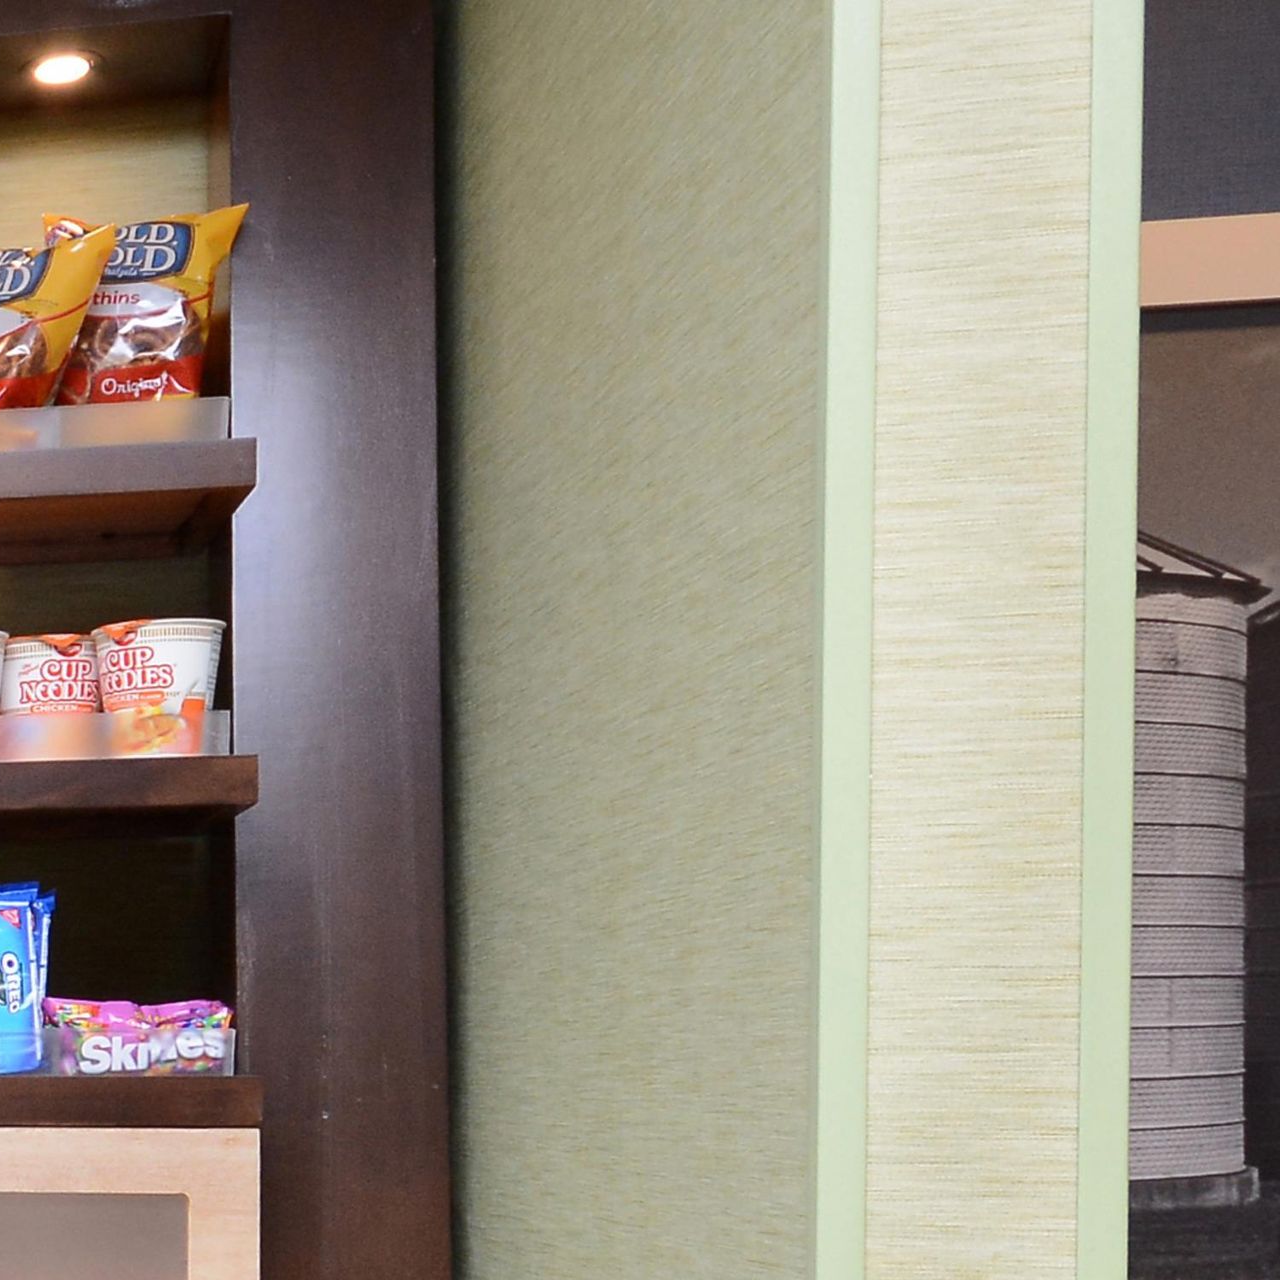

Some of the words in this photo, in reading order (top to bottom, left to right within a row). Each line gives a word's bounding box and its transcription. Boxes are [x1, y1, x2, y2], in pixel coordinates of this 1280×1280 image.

[115, 223, 175, 245] OLD
[106, 244, 177, 272] OLD
[92, 290, 141, 305] thins
[40, 660, 91, 681] CUP
[106, 647, 154, 673] CUP
[103, 666, 175, 693] OODLES
[32, 704, 79, 713] CHICKEN
[1, 952, 21, 1014] OREO
